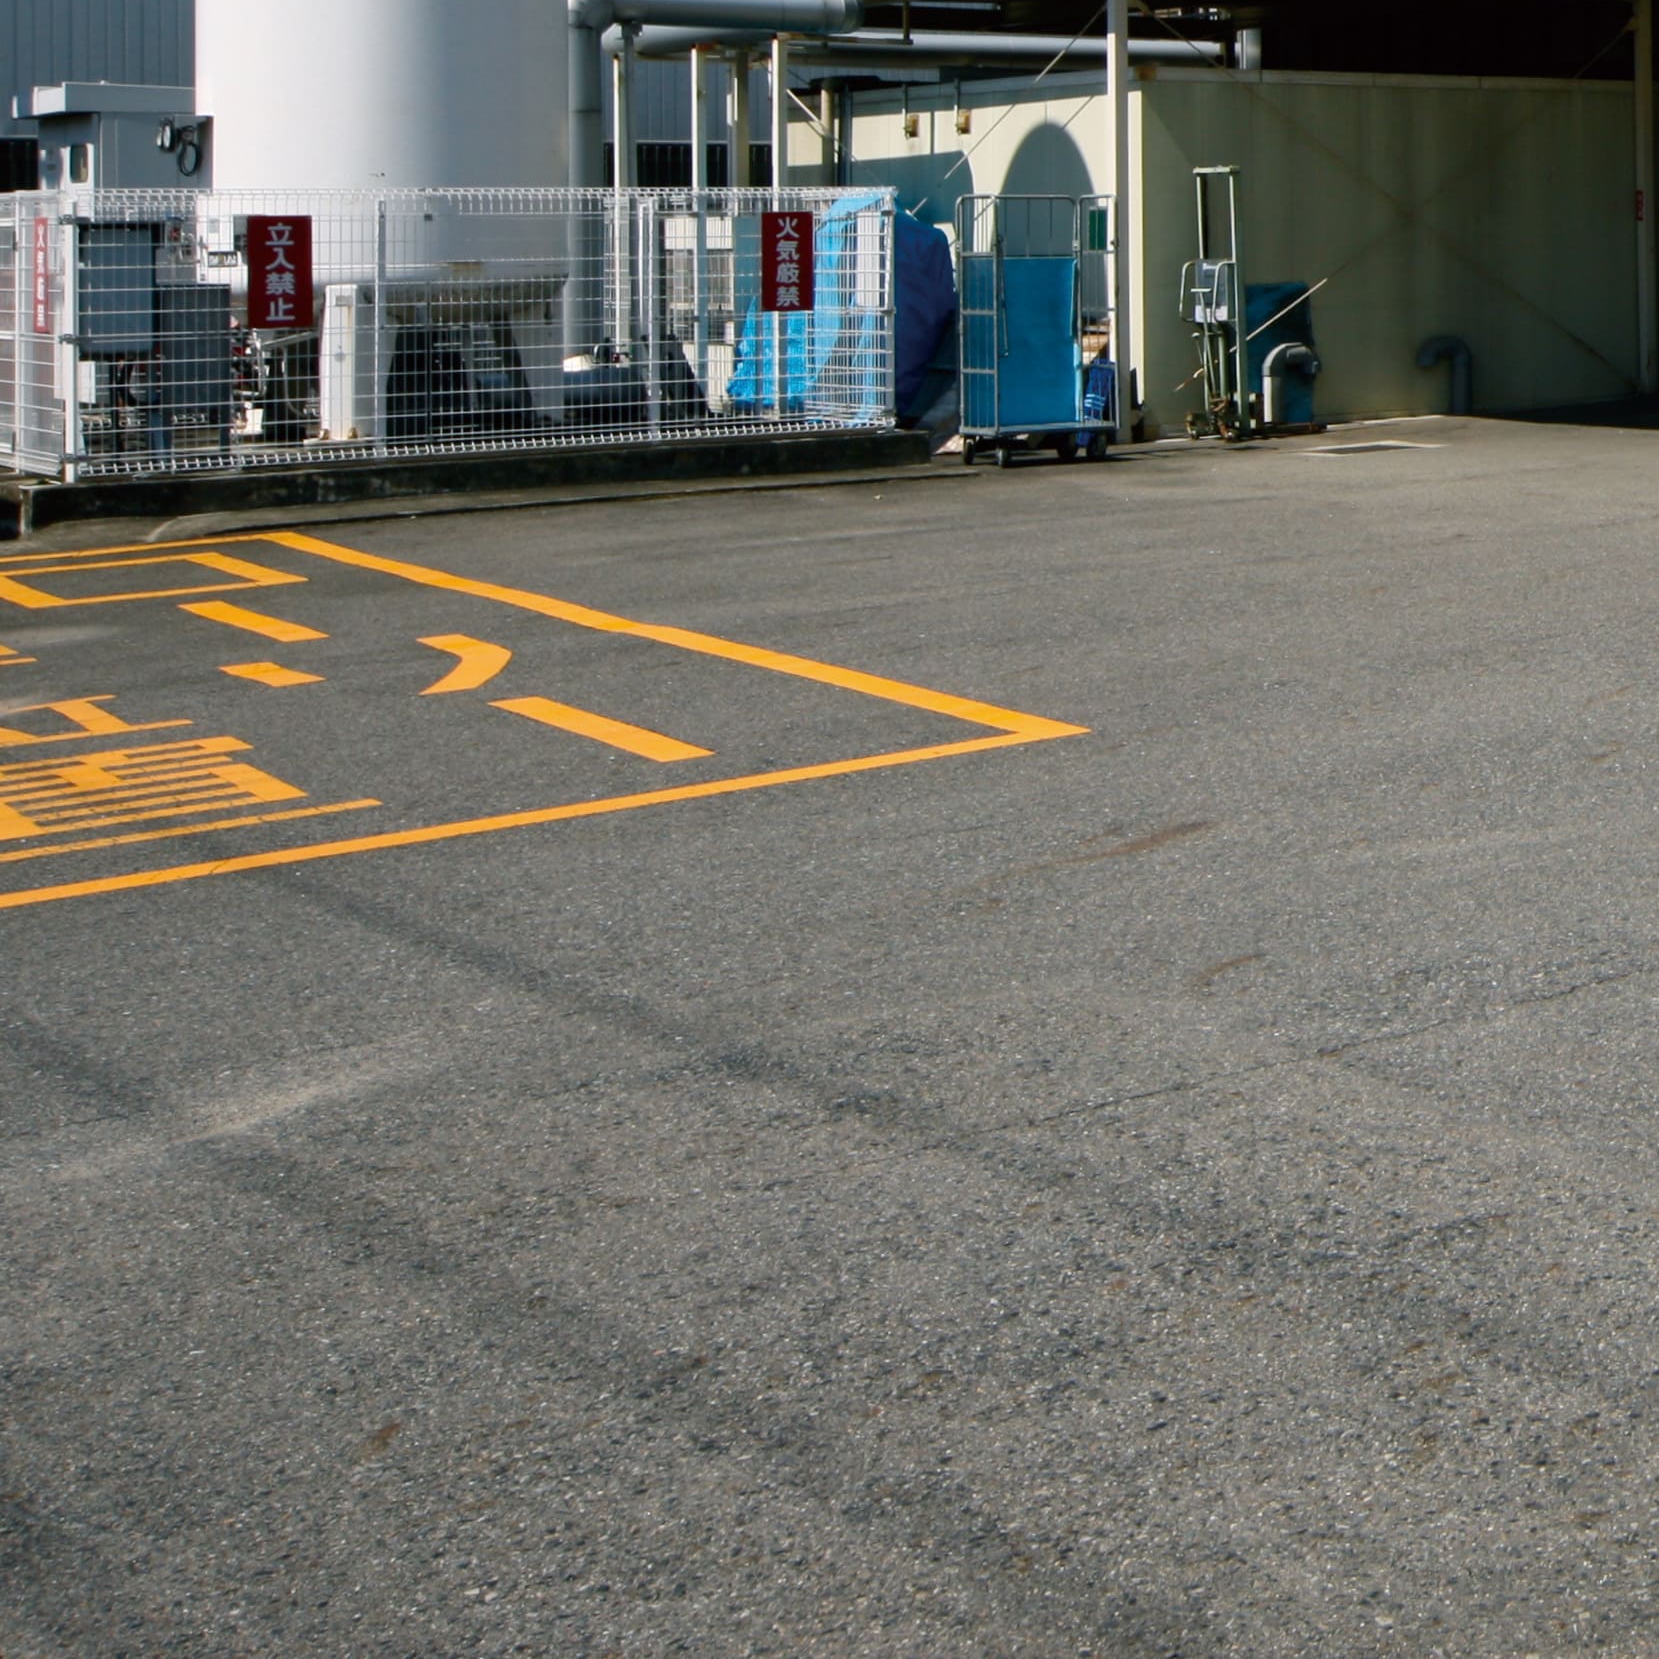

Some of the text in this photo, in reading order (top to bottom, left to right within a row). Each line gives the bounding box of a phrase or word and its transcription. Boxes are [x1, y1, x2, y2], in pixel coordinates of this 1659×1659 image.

[264, 221, 296, 322] 立入禁止
[775, 215, 801, 307] 火気厳禁
